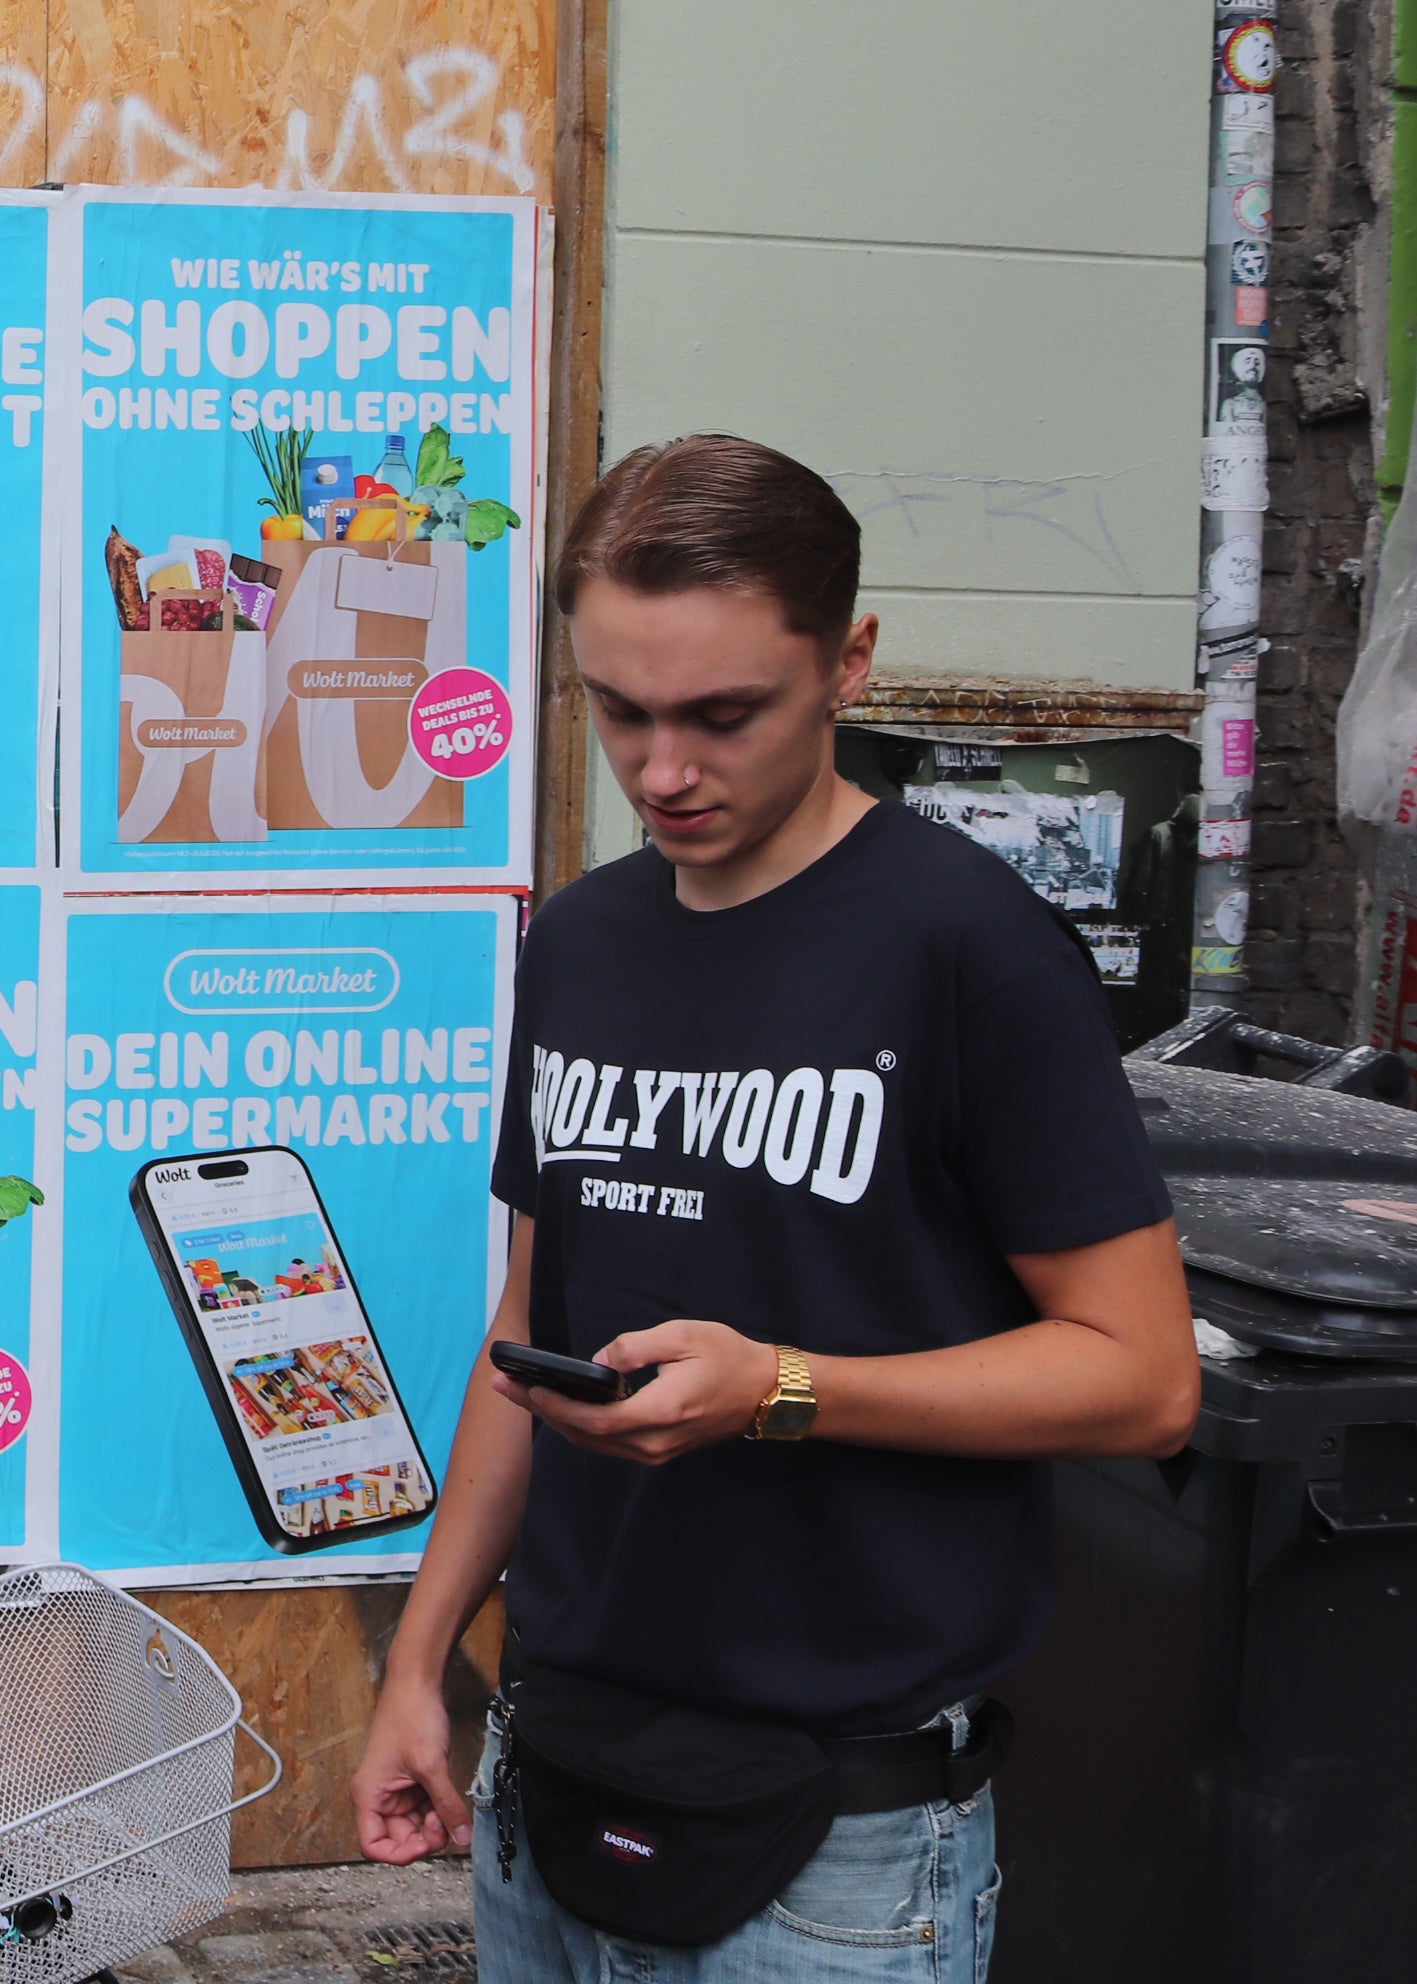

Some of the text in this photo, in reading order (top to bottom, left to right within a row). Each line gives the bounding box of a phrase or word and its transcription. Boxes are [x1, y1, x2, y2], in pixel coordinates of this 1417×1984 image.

[171, 258, 240, 288] WIE
[368, 263, 429, 293] MIT
[82, 297, 510, 382] SHOPPEN
[82, 387, 511, 434] OHNE SCHLEPPEN
[303, 671, 415, 688] Wolt Market
[417, 689, 493, 718] WECHSELNDE
[422, 703, 494, 731] DEALS BIS ZU
[149, 727, 237, 741] Wolt Market
[190, 968, 377, 995] Wolt Market
[66, 1027, 491, 1091] DEIN ONLINE
[65, 1092, 489, 1152] SUPERMARKT
[155, 1167, 191, 1184] Wolt
[581, 1177, 704, 1220] SPORT FREI
